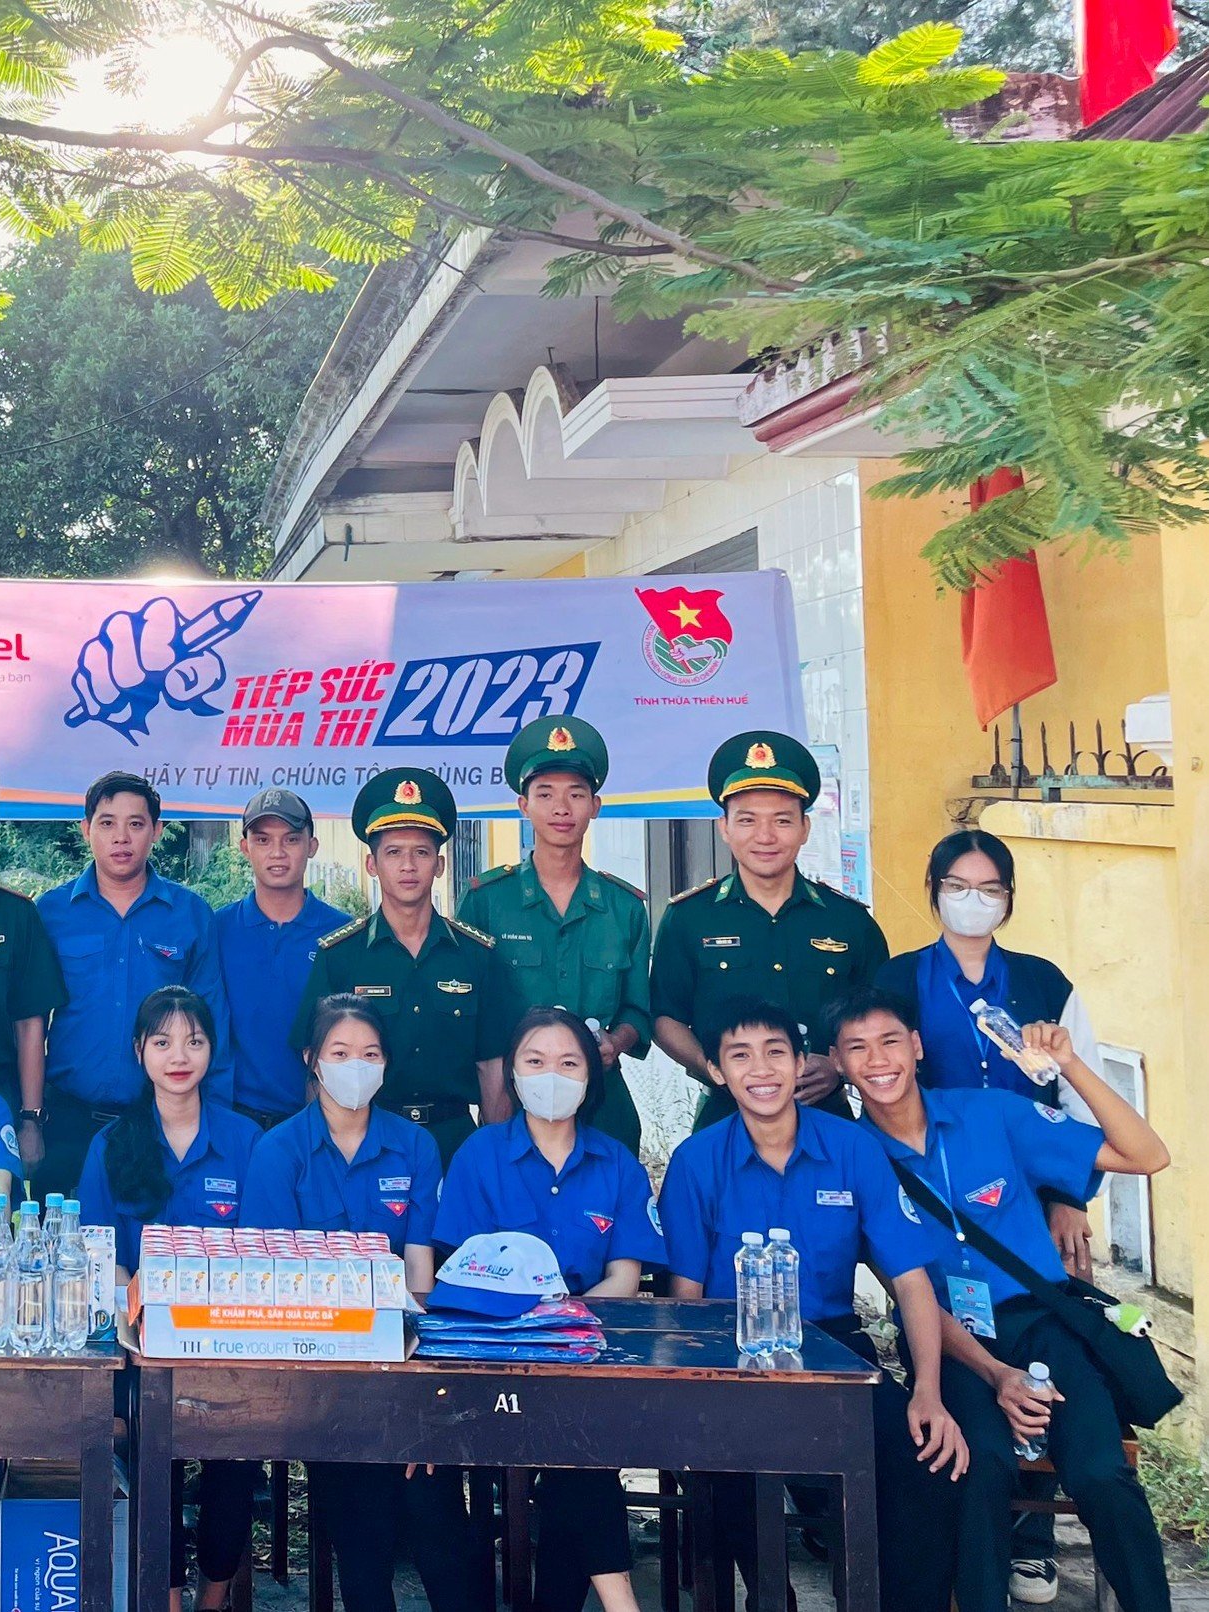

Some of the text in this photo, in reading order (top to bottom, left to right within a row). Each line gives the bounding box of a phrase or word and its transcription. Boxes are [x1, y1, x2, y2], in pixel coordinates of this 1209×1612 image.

[8, 671, 32, 685] bạn
[230, 659, 397, 710] TIẾP SỨC
[384, 650, 585, 736] 2023
[692, 694, 725, 705] THIÊN
[726, 693, 749, 705] HUẾ
[220, 708, 379, 747] MÙA THI
[144, 762, 187, 787] HÃY
[193, 765, 222, 790] TỰ
[228, 767, 264, 789] TIN,
[272, 762, 347, 787] CHÚNG
[354, 762, 389, 786] TÔ
[213, 1339, 243, 1354] true
[244, 1342, 290, 1355] YOGURT
[292, 1342, 337, 1356] TOPKID
[493, 1392, 522, 1414] A1
[43, 1531, 80, 1612] AQUA
